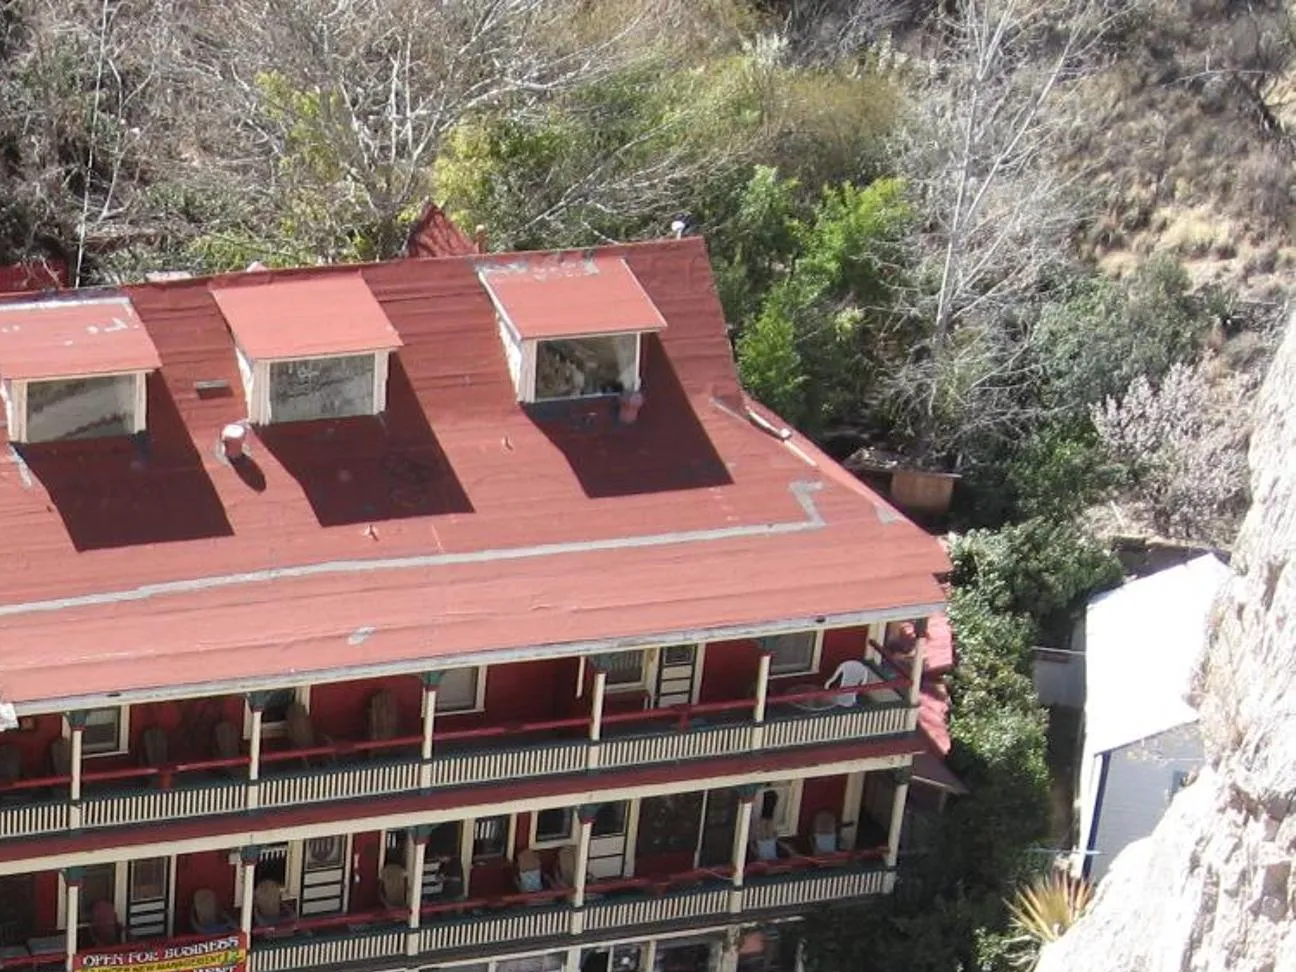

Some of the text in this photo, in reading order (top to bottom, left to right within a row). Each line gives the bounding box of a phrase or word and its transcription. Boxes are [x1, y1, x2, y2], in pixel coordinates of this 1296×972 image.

[83, 936, 239, 967] OPEN FOR BUSINESS
